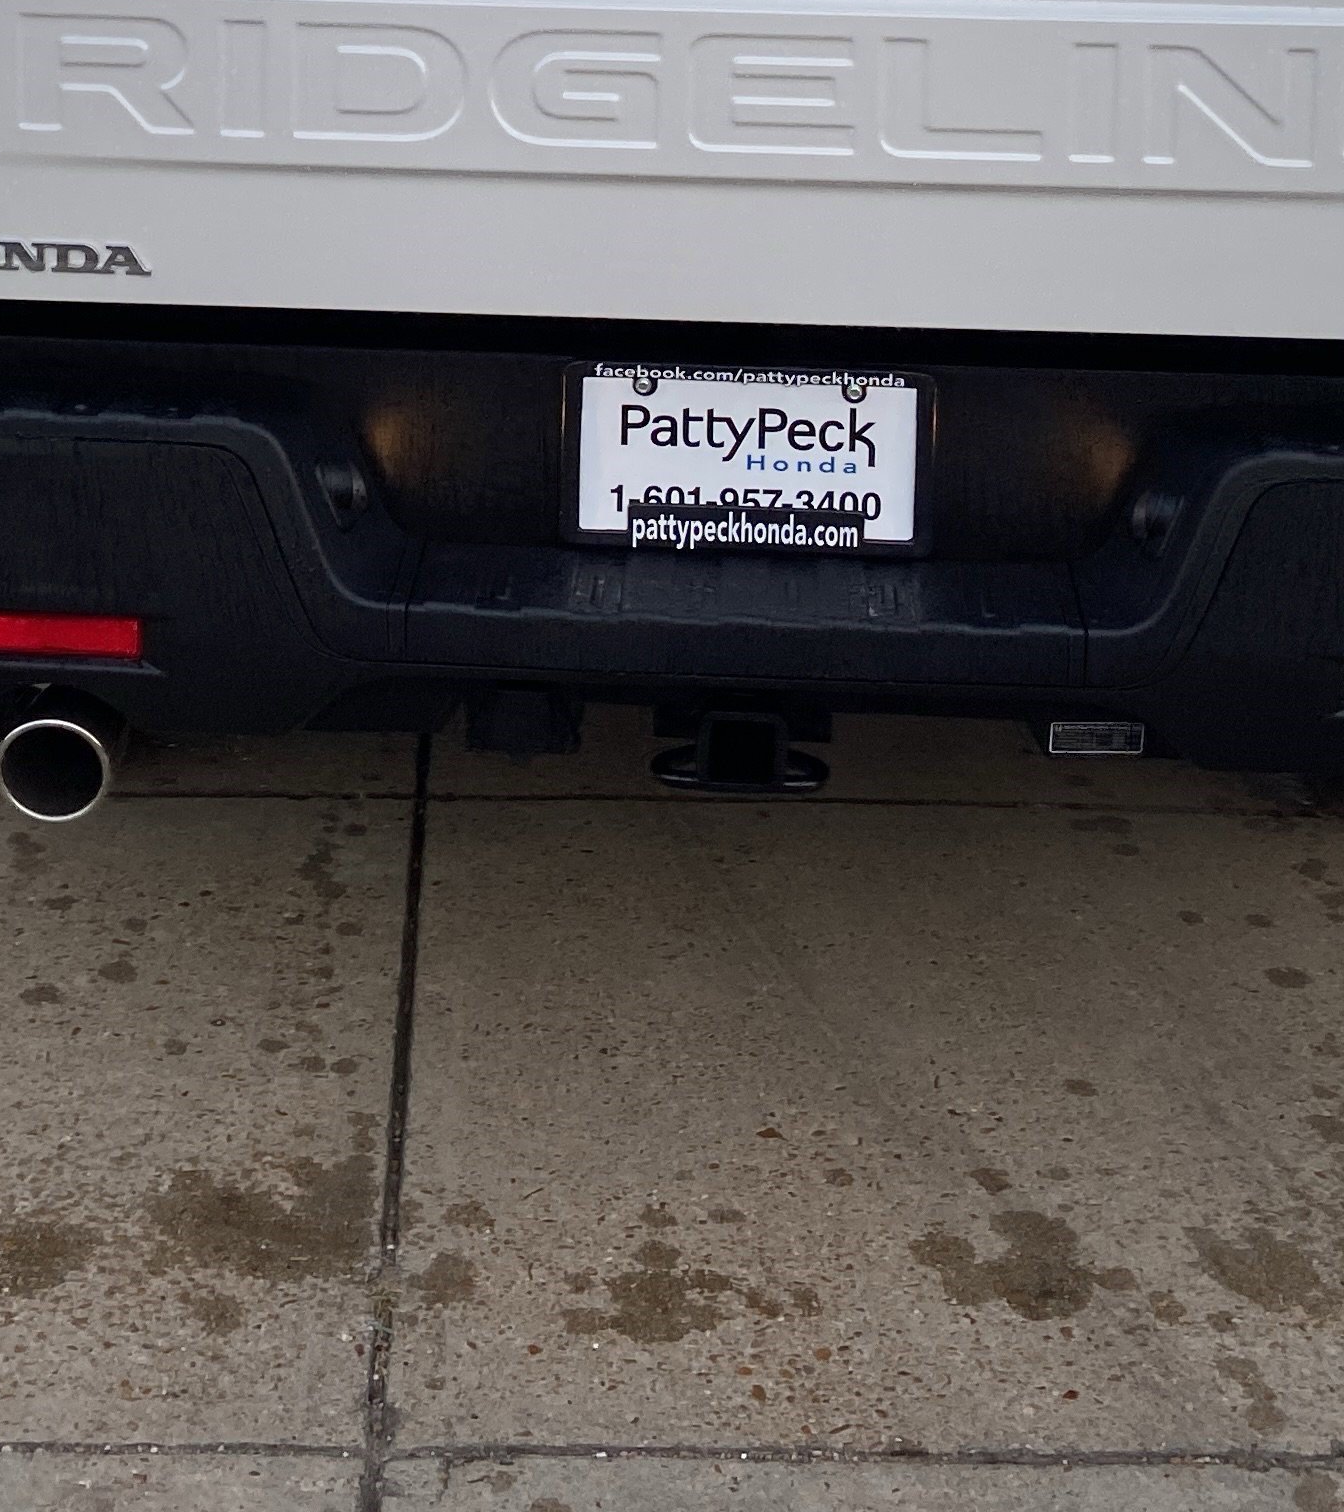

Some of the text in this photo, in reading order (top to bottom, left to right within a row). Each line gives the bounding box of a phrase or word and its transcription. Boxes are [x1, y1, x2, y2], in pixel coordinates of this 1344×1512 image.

[593, 362, 906, 388] facebook.com/pattypeckhonda
[746, 454, 857, 474] Honda
[631, 511, 858, 550] pattypeckhonda.com
